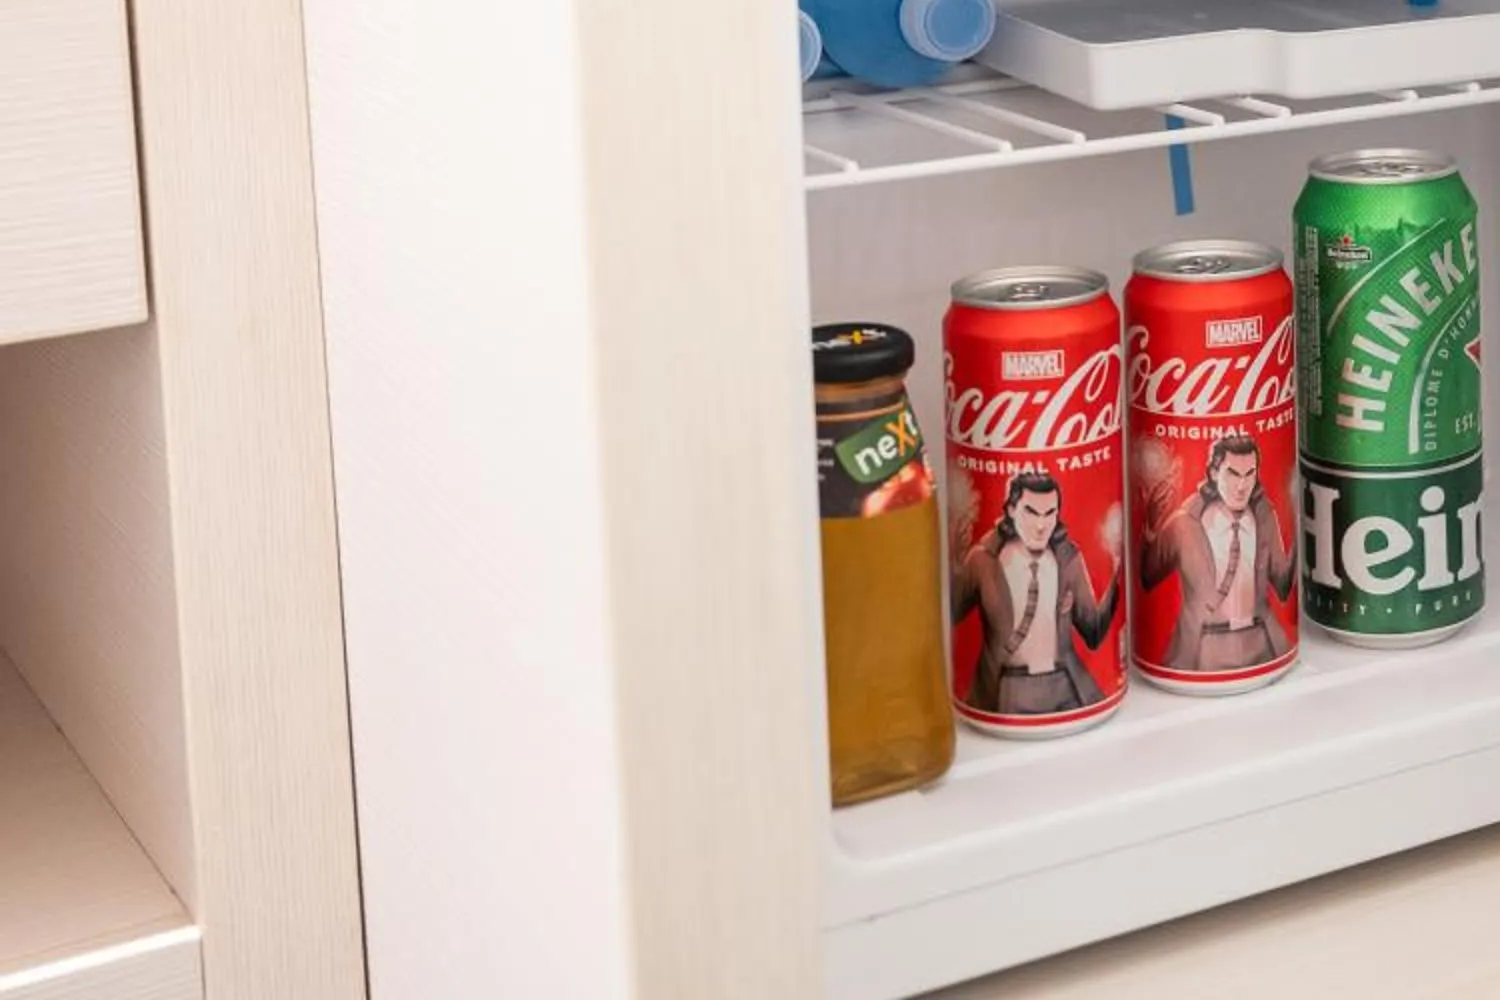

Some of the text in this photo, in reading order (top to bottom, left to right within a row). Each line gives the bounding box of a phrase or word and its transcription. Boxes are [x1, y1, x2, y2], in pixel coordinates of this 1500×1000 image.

[1208, 318, 1260, 346] MARVEL
[1335, 223, 1476, 433] HEINEKE
[1003, 352, 1063, 379] MARVEL
[1155, 423, 1250, 440] ORIGINAL
[957, 446, 1112, 474] ORIGINAL TASTE
